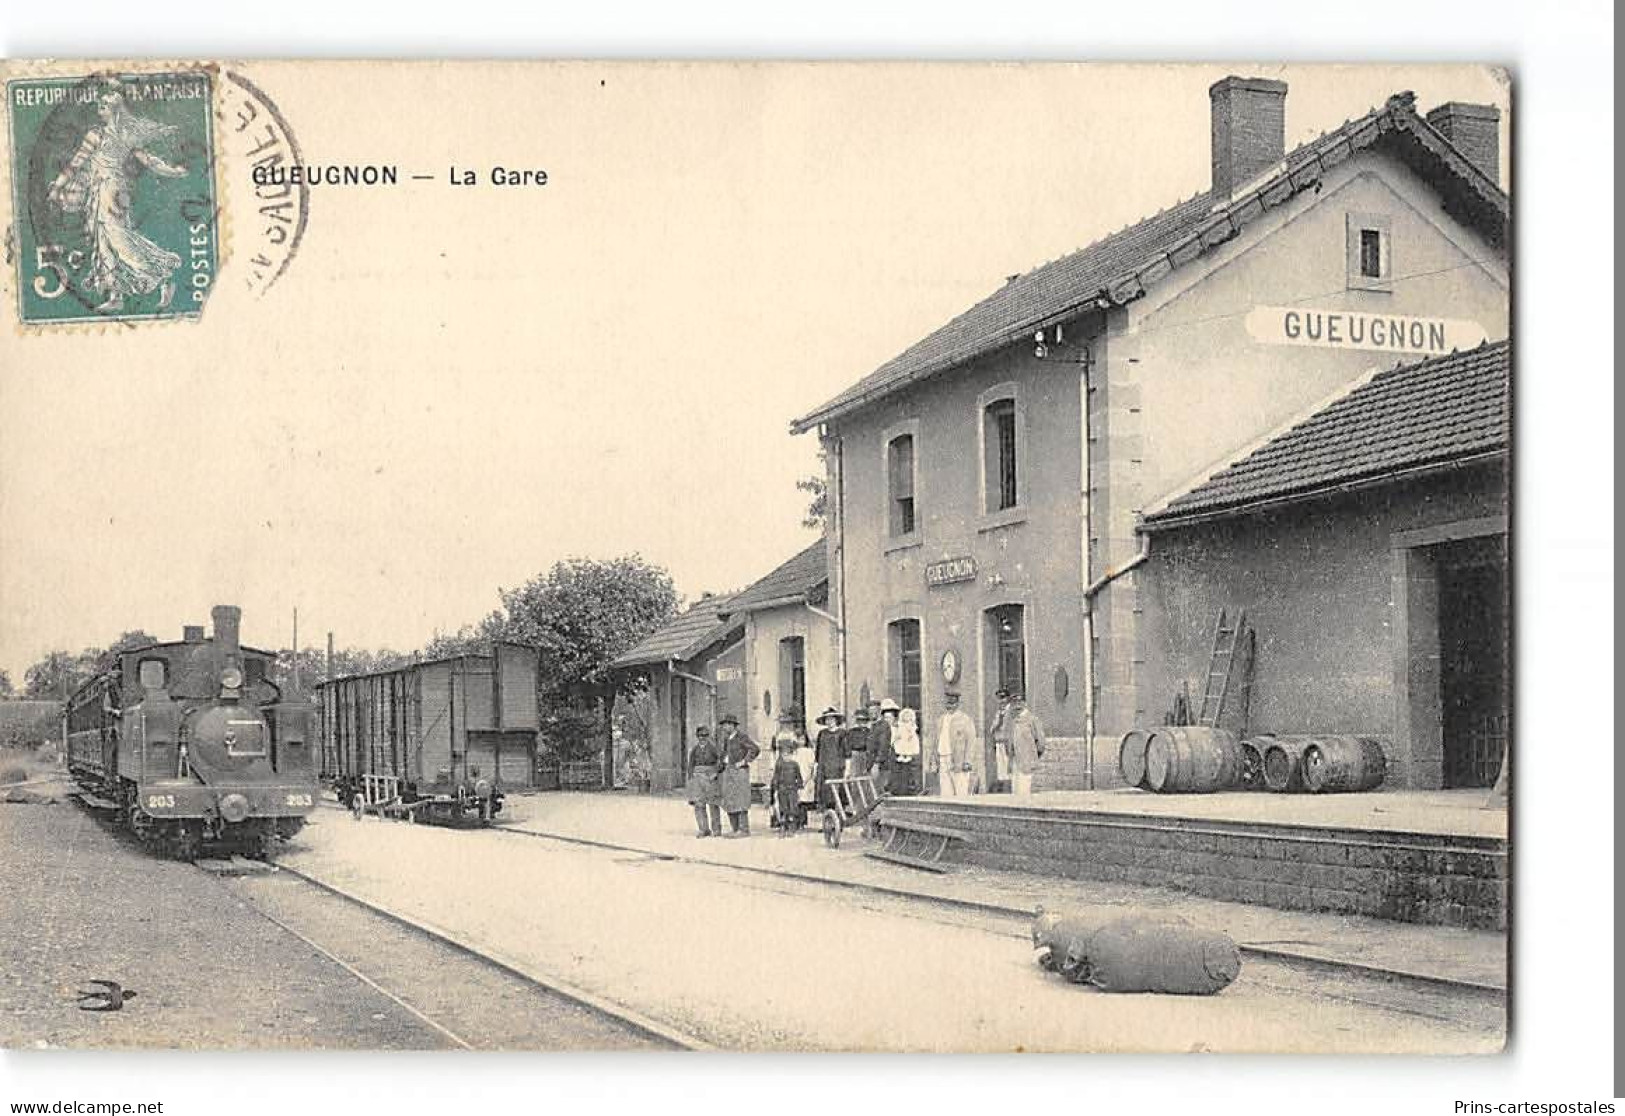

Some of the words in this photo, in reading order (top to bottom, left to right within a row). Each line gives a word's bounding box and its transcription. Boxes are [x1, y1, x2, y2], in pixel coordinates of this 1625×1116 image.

[251, 165, 399, 186] GUEUGNON
[450, 166, 476, 186] La
[490, 166, 549, 186] Gare
[191, 223, 208, 302] POSTES
[1284, 310, 1447, 351] GUEUGNON
[148, 794, 176, 809] 203
[285, 793, 313, 807] 203
